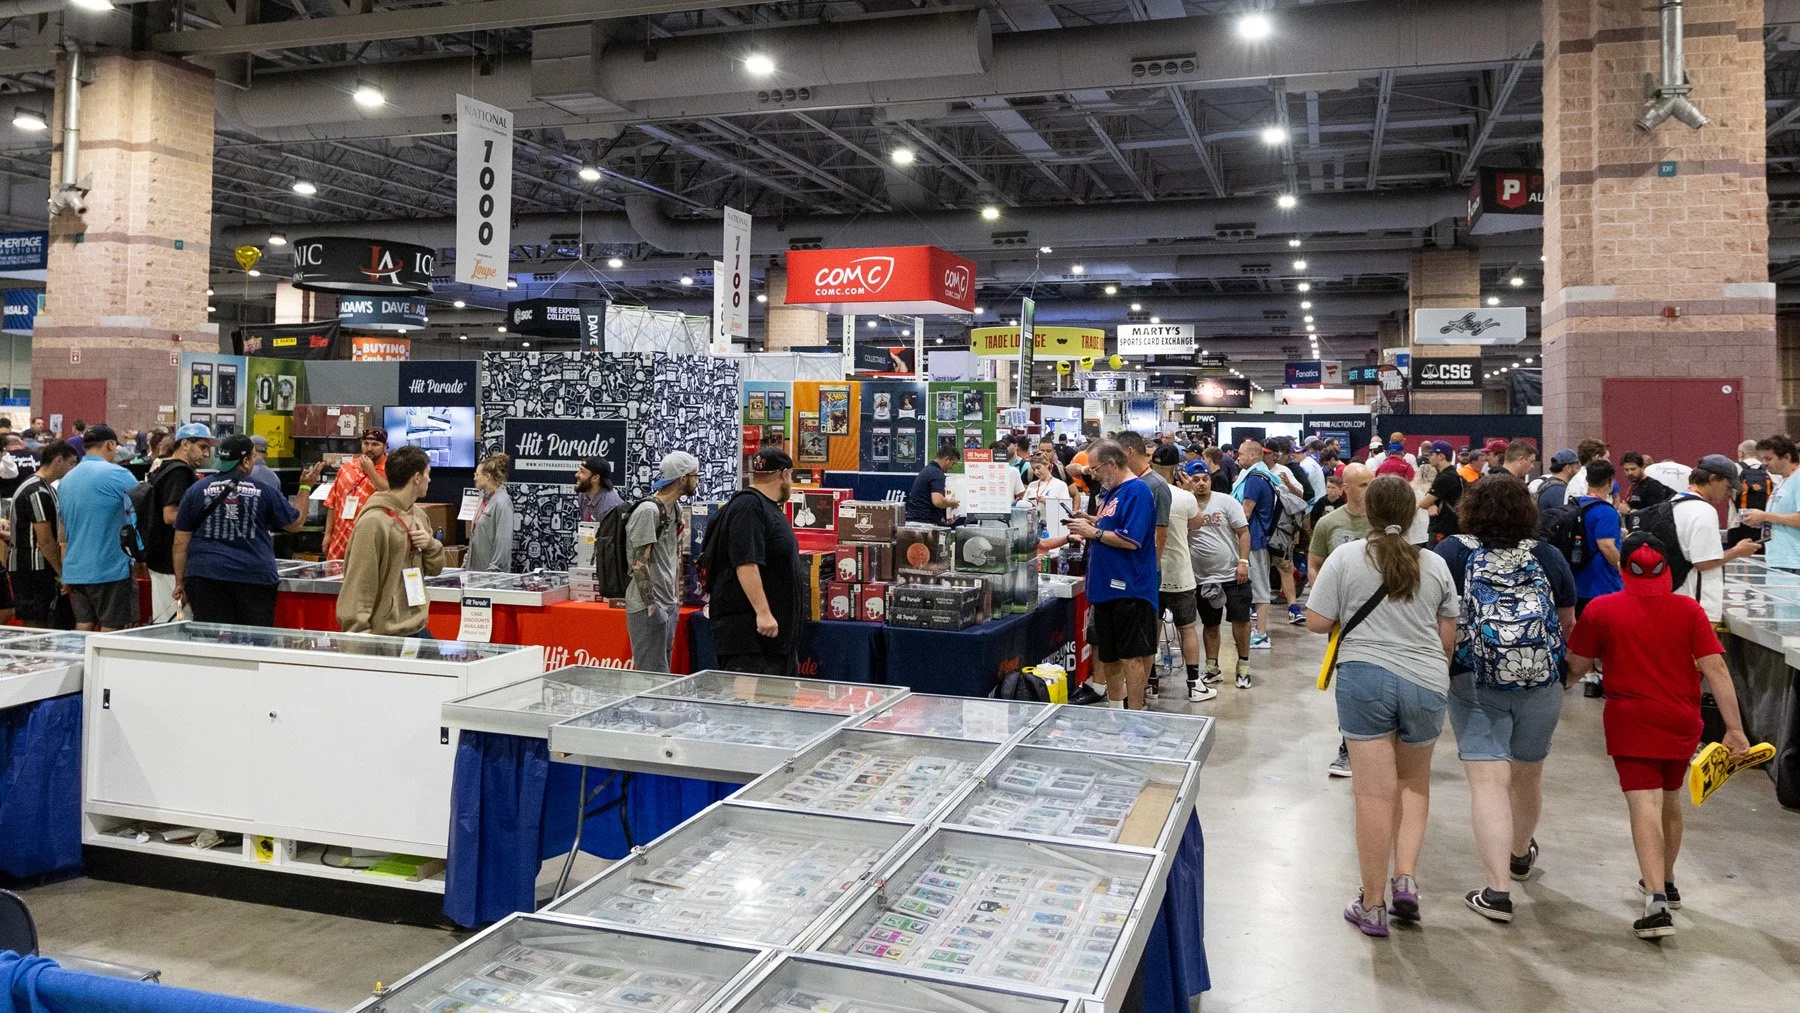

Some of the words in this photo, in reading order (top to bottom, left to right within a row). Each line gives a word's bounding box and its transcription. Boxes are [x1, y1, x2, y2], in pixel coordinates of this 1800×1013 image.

[464, 104, 508, 129] NATIONAL
[478, 140, 494, 246] 1000
[0, 236, 42, 249] HERITAGE
[732, 235, 741, 309] 1100
[815, 265, 882, 287] COMC
[815, 287, 865, 296] COMC.COM
[341, 301, 373, 314] ADAM'S
[381, 301, 411, 314] DAVE
[546, 306, 558, 314] THE
[586, 314, 599, 346] DAVE
[1131, 326, 1181, 337] MARTY'S
[985, 335, 1008, 349] TRADE
[1010, 334, 1047, 348] LOGE
[1120, 338, 1142, 346] SPORTS
[1144, 338, 1160, 346] CARD
[1161, 337, 1194, 346] EXCHANGE
[362, 344, 405, 354] BUYING
[1295, 369, 1319, 378] Fanatics
[1439, 364, 1472, 379] CSG
[409, 378, 426, 394] Hit
[427, 378, 464, 394] Parade
[344, 420, 351, 429] 16
[516, 431, 545, 456] Hit
[547, 433, 610, 458] Parade
